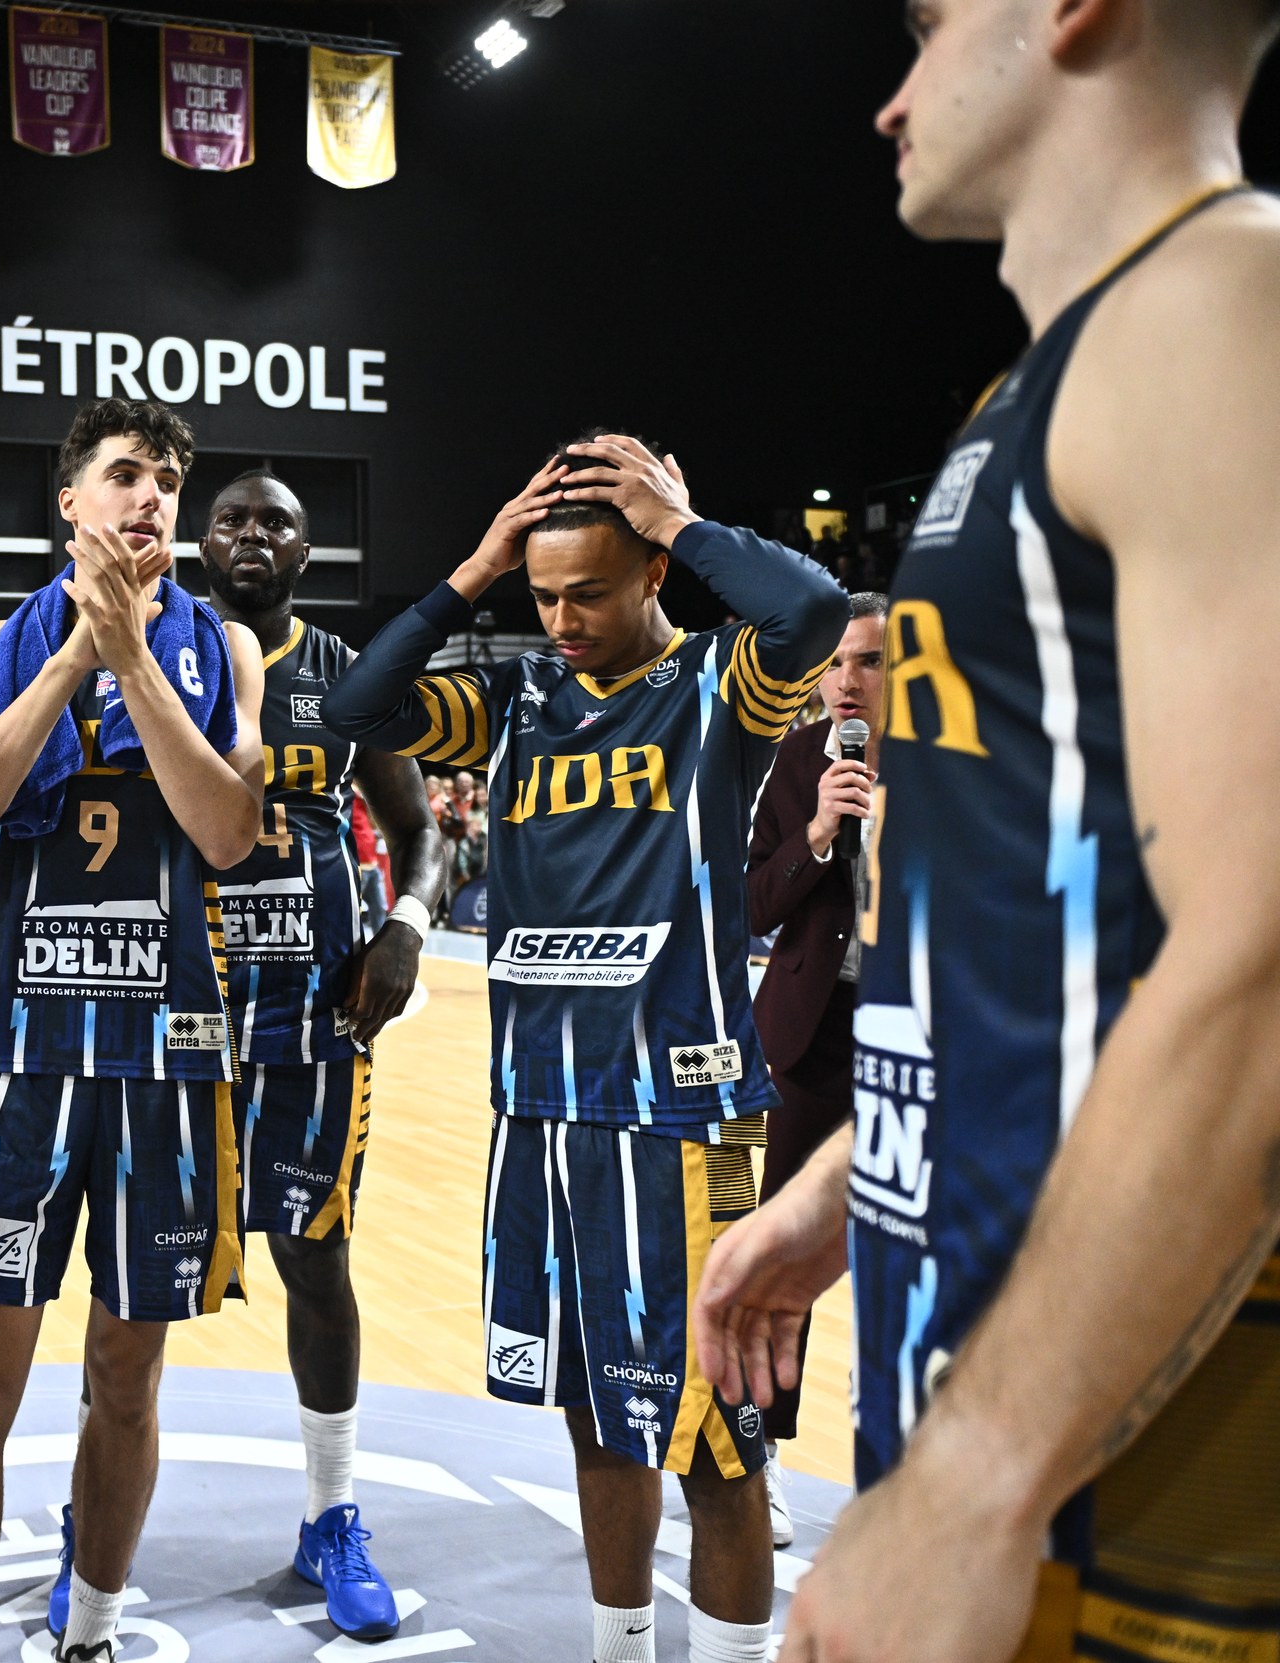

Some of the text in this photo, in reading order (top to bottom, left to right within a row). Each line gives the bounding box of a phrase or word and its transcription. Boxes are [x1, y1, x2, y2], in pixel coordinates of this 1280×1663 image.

[21, 44, 97, 70] VAINQUEUR
[29, 69, 90, 94] LEADERS
[170, 61, 243, 89] VAINQUEUR
[45, 94, 74, 116] CUP
[185, 86, 228, 111] COUPE
[173, 108, 243, 137] DE FRANCE
[501, 744, 676, 824] JDA
[79, 801, 120, 872] 9
[22, 921, 168, 938] FROMAGERIE
[509, 933, 649, 961] ISERBA
[24, 937, 161, 978] DELIN
[506, 966, 636, 983] Maintenance immobilière
[17, 987, 165, 1000] BOURGOGNE-FRANCHE-COMTÉ
[203, 1017, 223, 1026] SIZE
[169, 1036, 200, 1048] errea
[210, 1030, 218, 1040] L
[713, 1045, 736, 1057] SIZE
[721, 1059, 733, 1071] M
[676, 1071, 713, 1085] errea
[273, 1162, 334, 1184] CHOPARD
[283, 1200, 310, 1213] errea
[174, 1276, 202, 1289] errea
[621, 1360, 655, 1371] GROUPE
[603, 1364, 677, 1386] CHOPARD
[627, 1416, 661, 1433] errea
